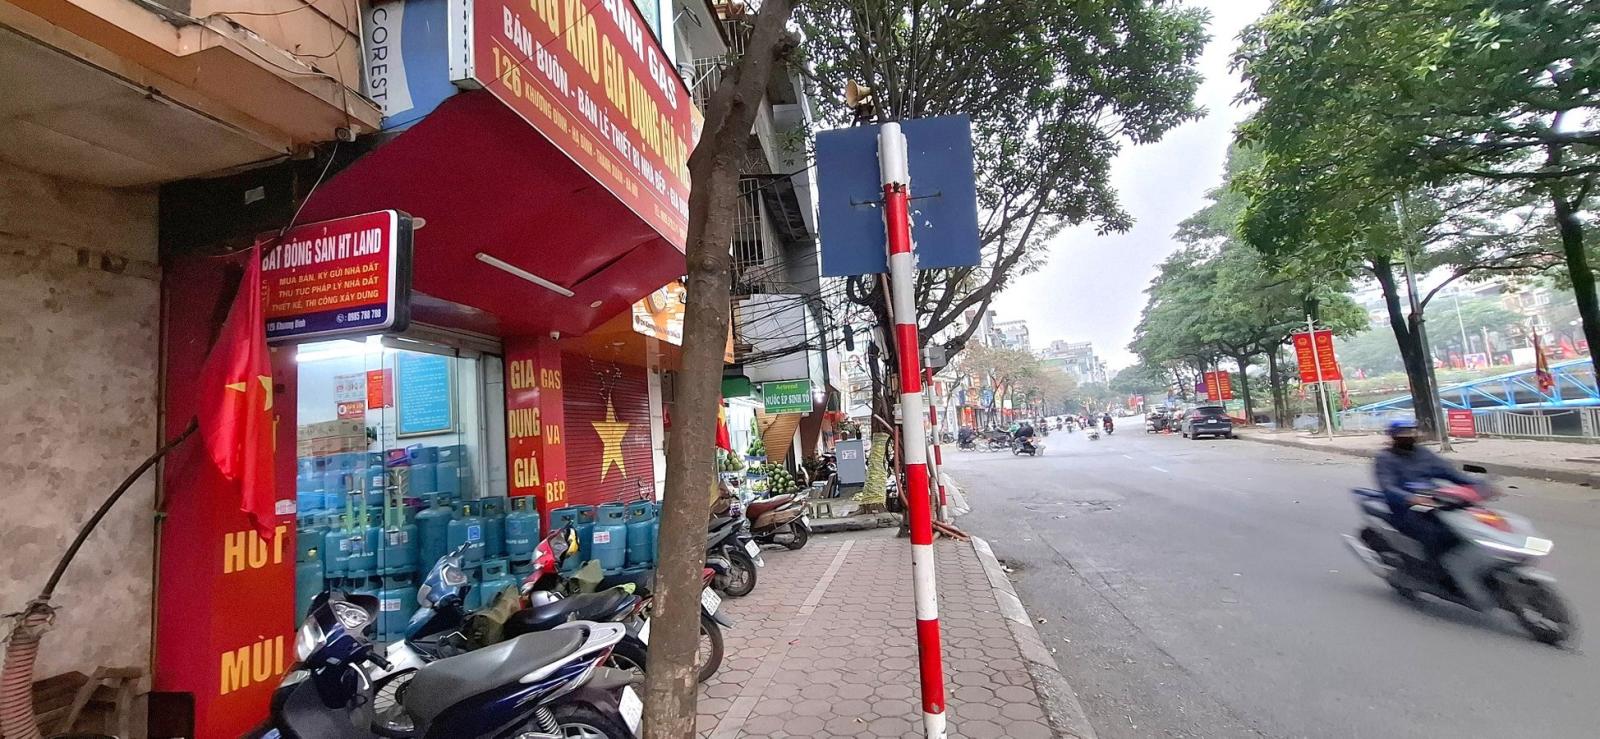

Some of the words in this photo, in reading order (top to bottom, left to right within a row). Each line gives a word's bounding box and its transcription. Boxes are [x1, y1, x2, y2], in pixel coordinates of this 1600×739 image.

[492, 46, 521, 98] 126
[503, 5, 533, 61] BÁN
[536, 40, 568, 98] BUÔN
[577, 86, 598, 128] BÁN
[600, 106, 610, 140] LẺ
[610, 121, 631, 161] THIẾT
[565, 0, 600, 85] KHO
[602, 33, 628, 119] GIA
[628, 66, 661, 158] DỤNG
[647, 45, 677, 110] GAS
[284, 238, 312, 273] ĐỘNG
[315, 227, 336, 263] SẢN
[338, 234, 351, 261] HT
[353, 228, 382, 256] LAND
[279, 276, 297, 286] MUA
[362, 261, 379, 273] ĐẤT
[311, 282, 332, 295] PHÁP
[333, 280, 343, 291] LÝ
[362, 274, 379, 287] ĐẤT
[305, 298, 317, 308] THI
[317, 293, 338, 306] CÔNG
[339, 290, 356, 303] XÂY
[356, 289, 379, 303] DỰNG
[510, 359, 535, 390] GIA
[540, 368, 561, 389] GAS
[508, 407, 541, 445] DỤNG
[514, 450, 540, 488] GIÁ
[220, 635, 284, 695] MÙI
